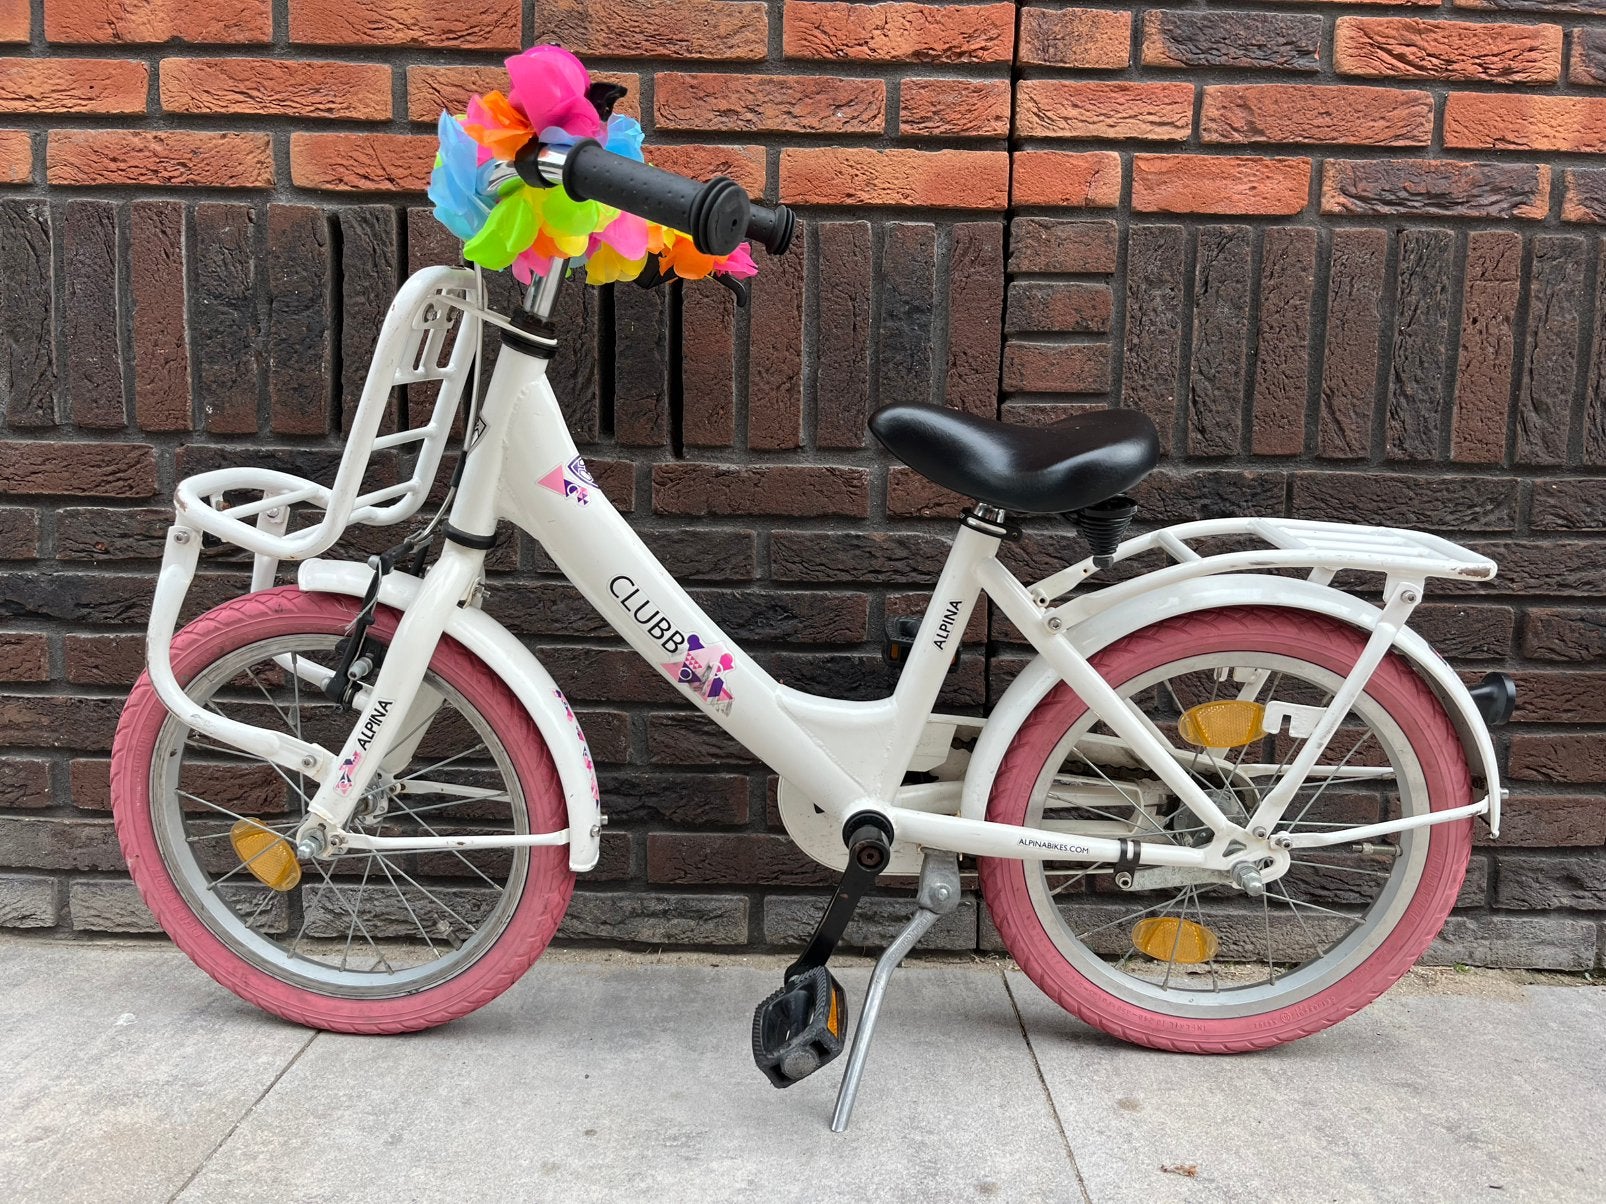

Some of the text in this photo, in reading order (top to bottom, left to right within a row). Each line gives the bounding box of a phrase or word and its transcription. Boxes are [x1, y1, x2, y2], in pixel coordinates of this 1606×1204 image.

[609, 575, 686, 654] CLUBB
[933, 600, 963, 650] ALPINA
[356, 700, 394, 751] ALPINA
